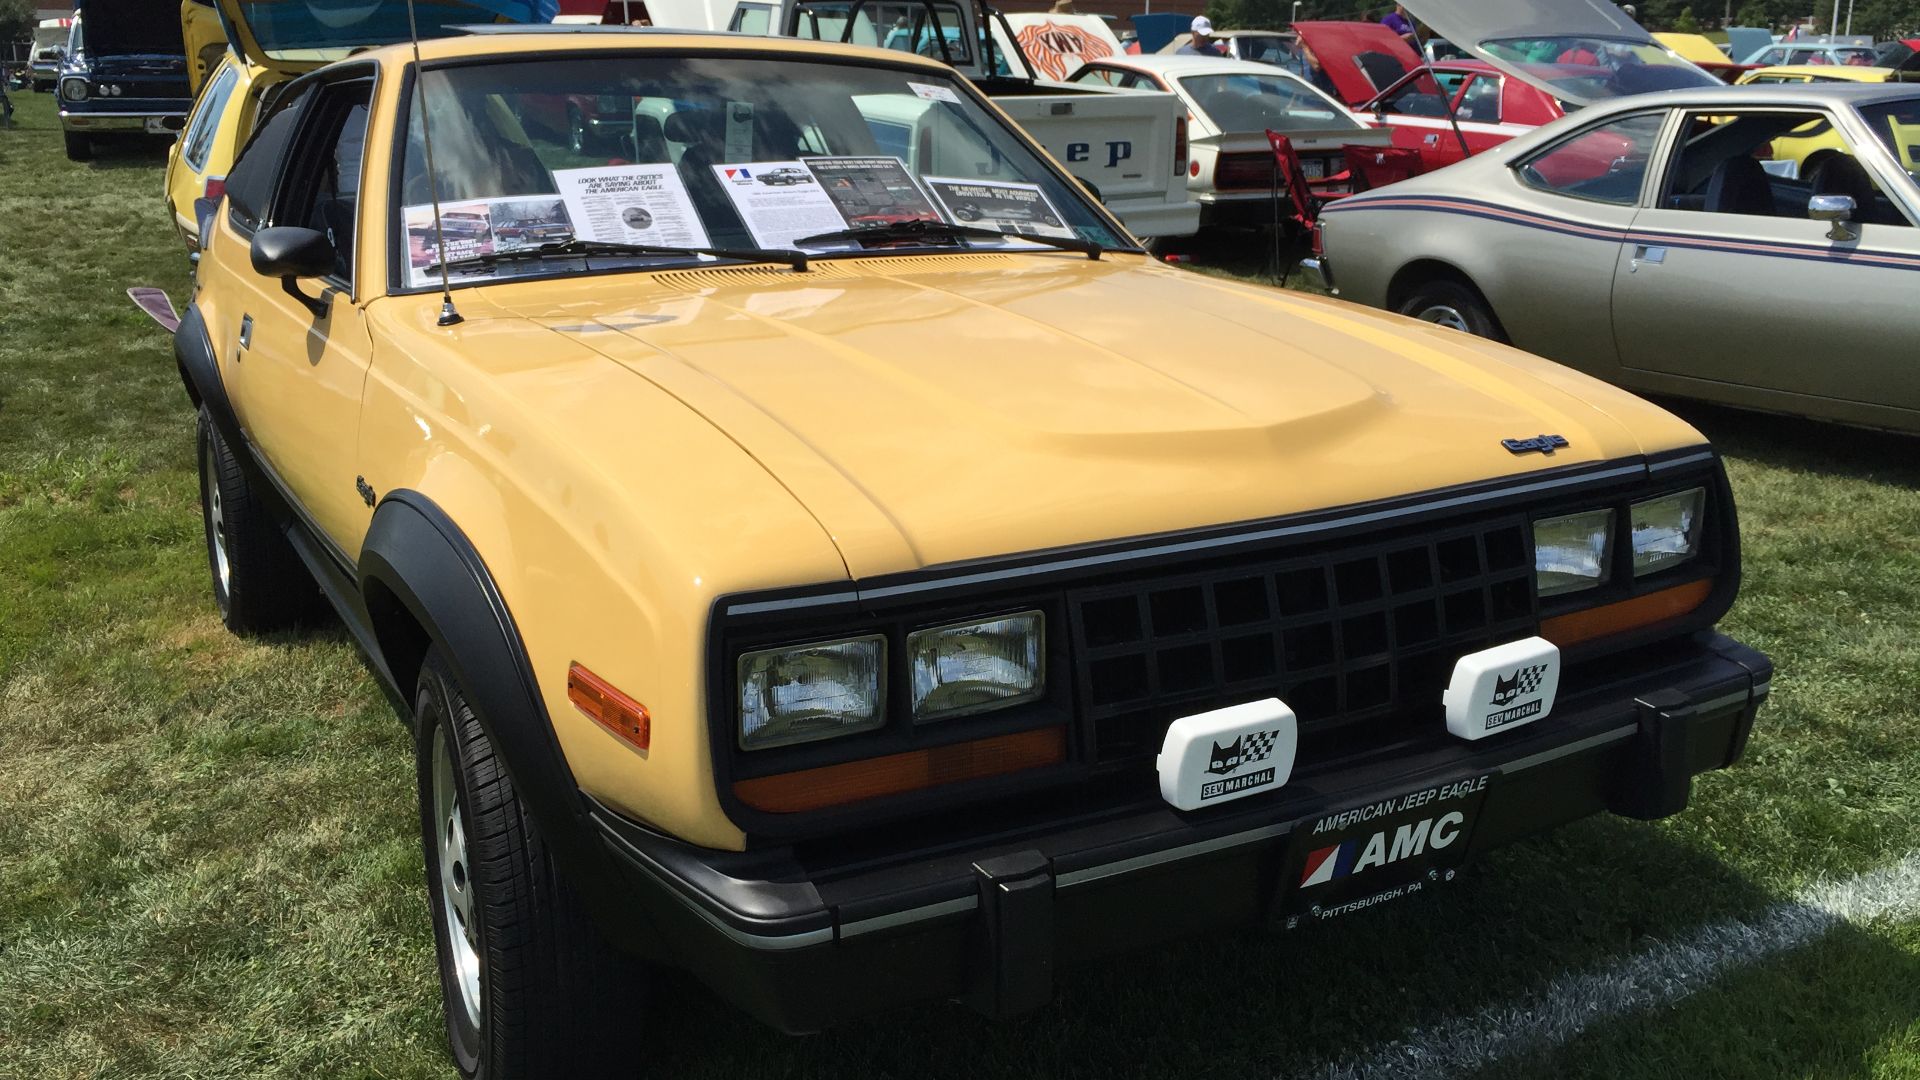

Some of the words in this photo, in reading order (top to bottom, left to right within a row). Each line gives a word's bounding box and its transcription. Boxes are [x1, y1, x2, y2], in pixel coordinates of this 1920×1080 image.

[1501, 435, 1568, 453] Eagle
[1504, 702, 1540, 721] MARCHAL
[1225, 770, 1272, 792] MARCHAL
[1312, 799, 1396, 835] AMERICAN
[1398, 788, 1437, 812] JEEP
[1438, 775, 1489, 801] EAGLE
[1352, 811, 1464, 874] AMC
[1407, 882, 1422, 894] PA
